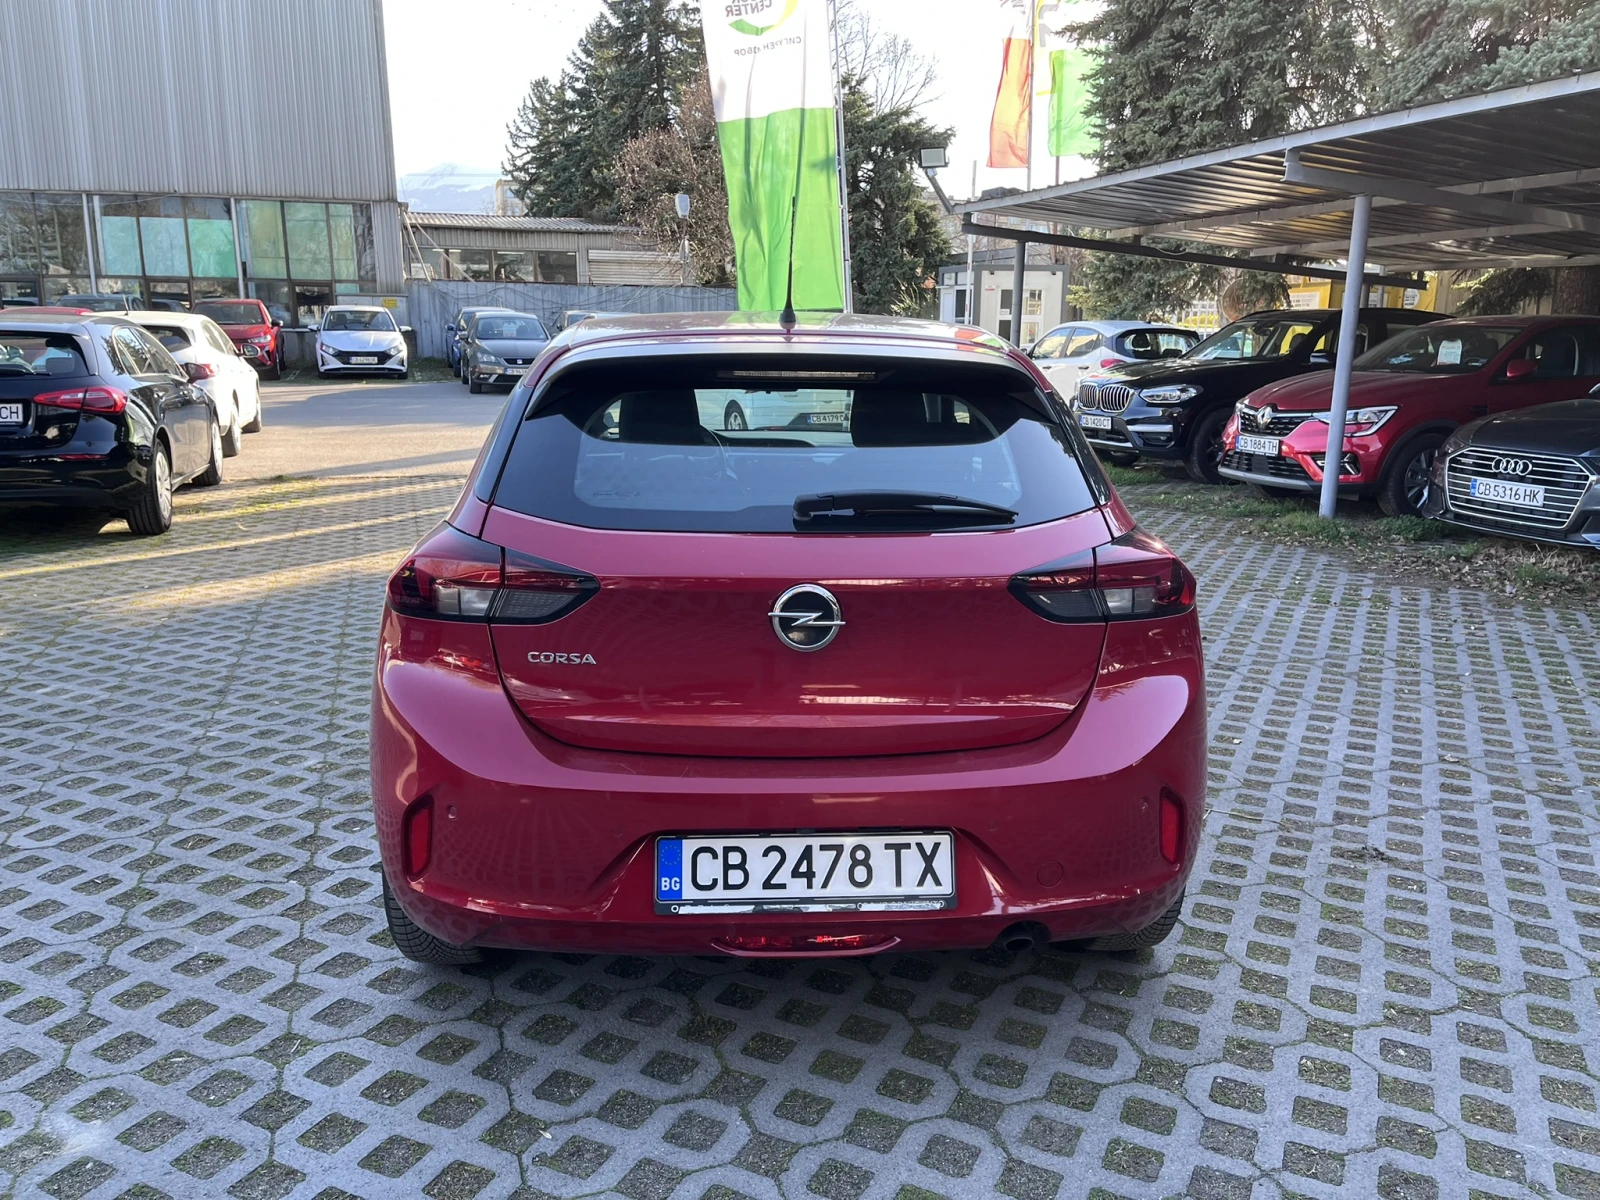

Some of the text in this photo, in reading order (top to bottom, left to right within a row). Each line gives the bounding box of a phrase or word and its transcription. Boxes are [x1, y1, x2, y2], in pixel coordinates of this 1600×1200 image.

[0, 406, 19, 420] CH
[811, 415, 821, 423] CB
[1240, 437, 1278, 452] CB 1884 TH
[1477, 482, 1540, 504] CB 5316 HK
[527, 651, 597, 665] CORSA
[690, 841, 943, 891] CB 2478 TX
[661, 877, 681, 891] BG
